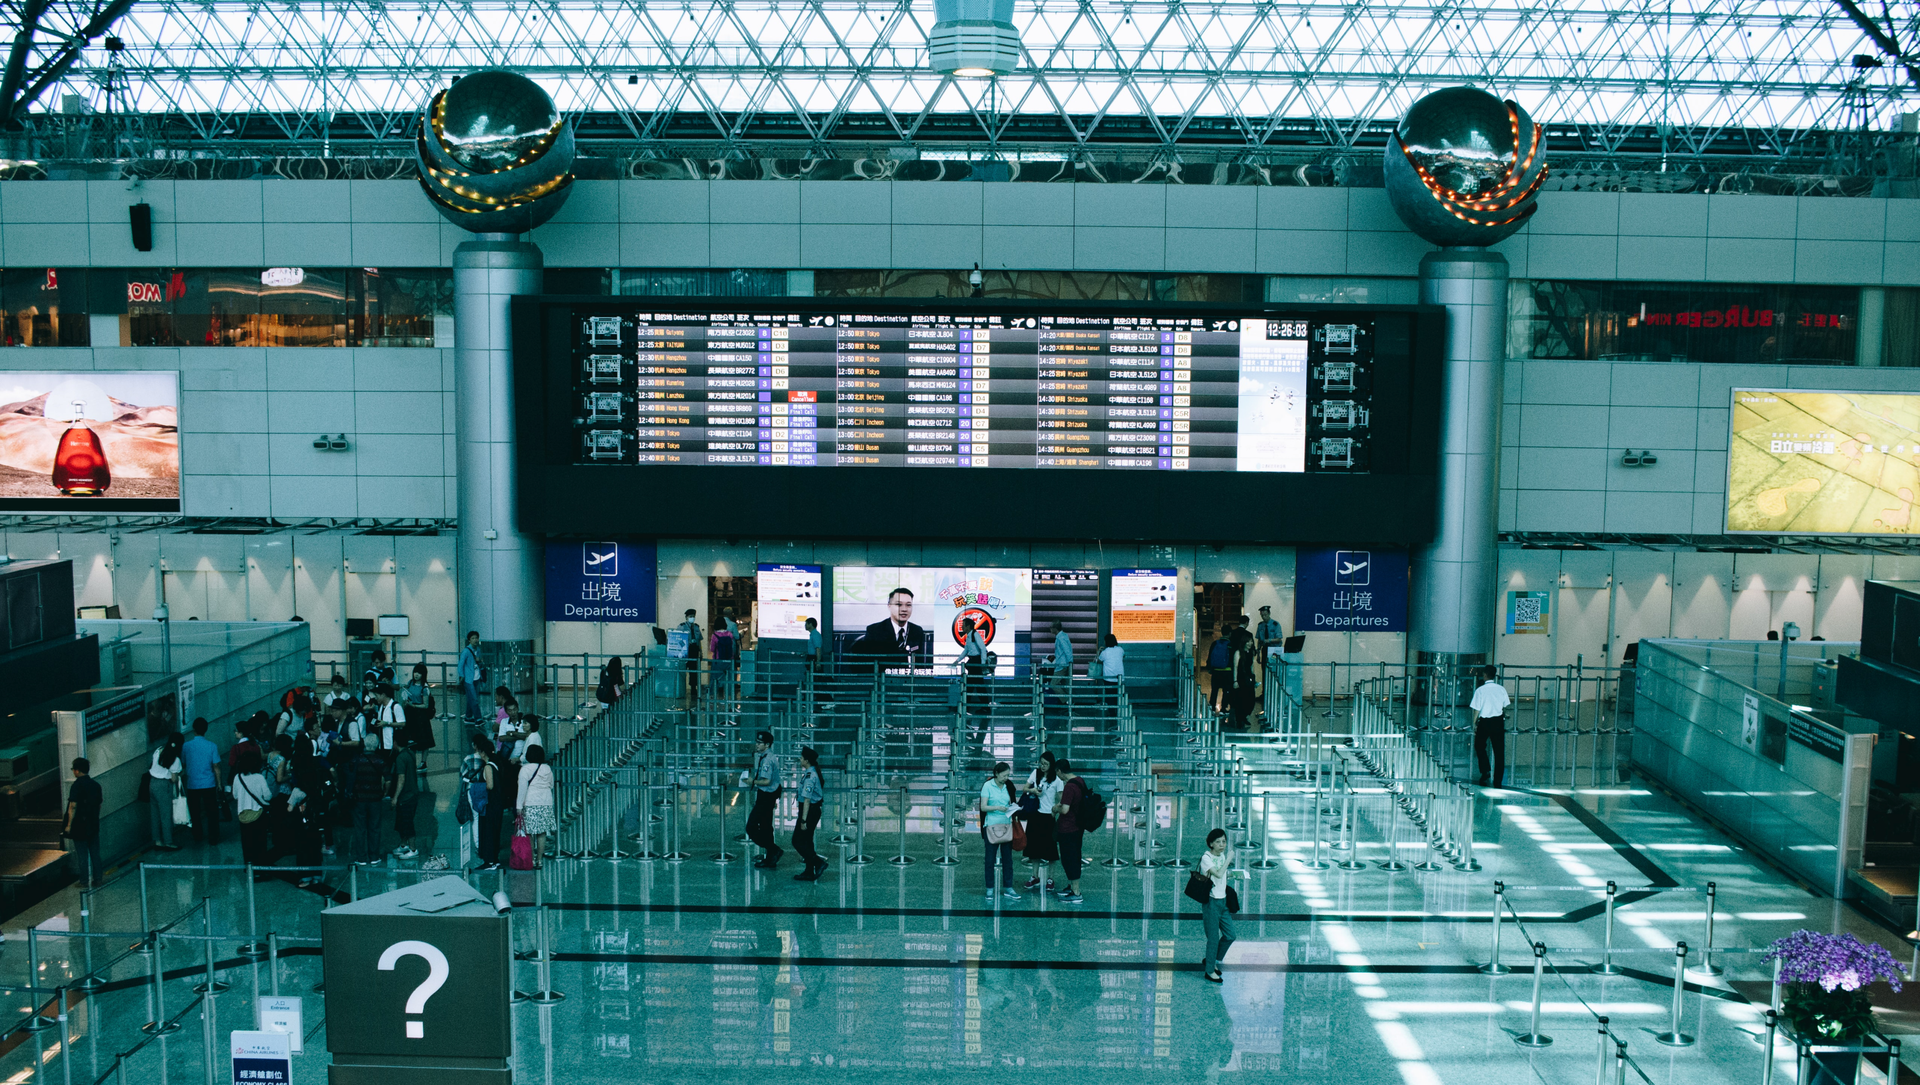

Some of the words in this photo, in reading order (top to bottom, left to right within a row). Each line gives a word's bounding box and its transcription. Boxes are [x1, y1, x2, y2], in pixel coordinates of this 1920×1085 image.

[1268, 324, 1306, 337] 12:26:03
[581, 582, 622, 601] 出境
[1332, 590, 1373, 611] 出境
[564, 604, 638, 619] Departures
[1314, 614, 1389, 629] Departures
